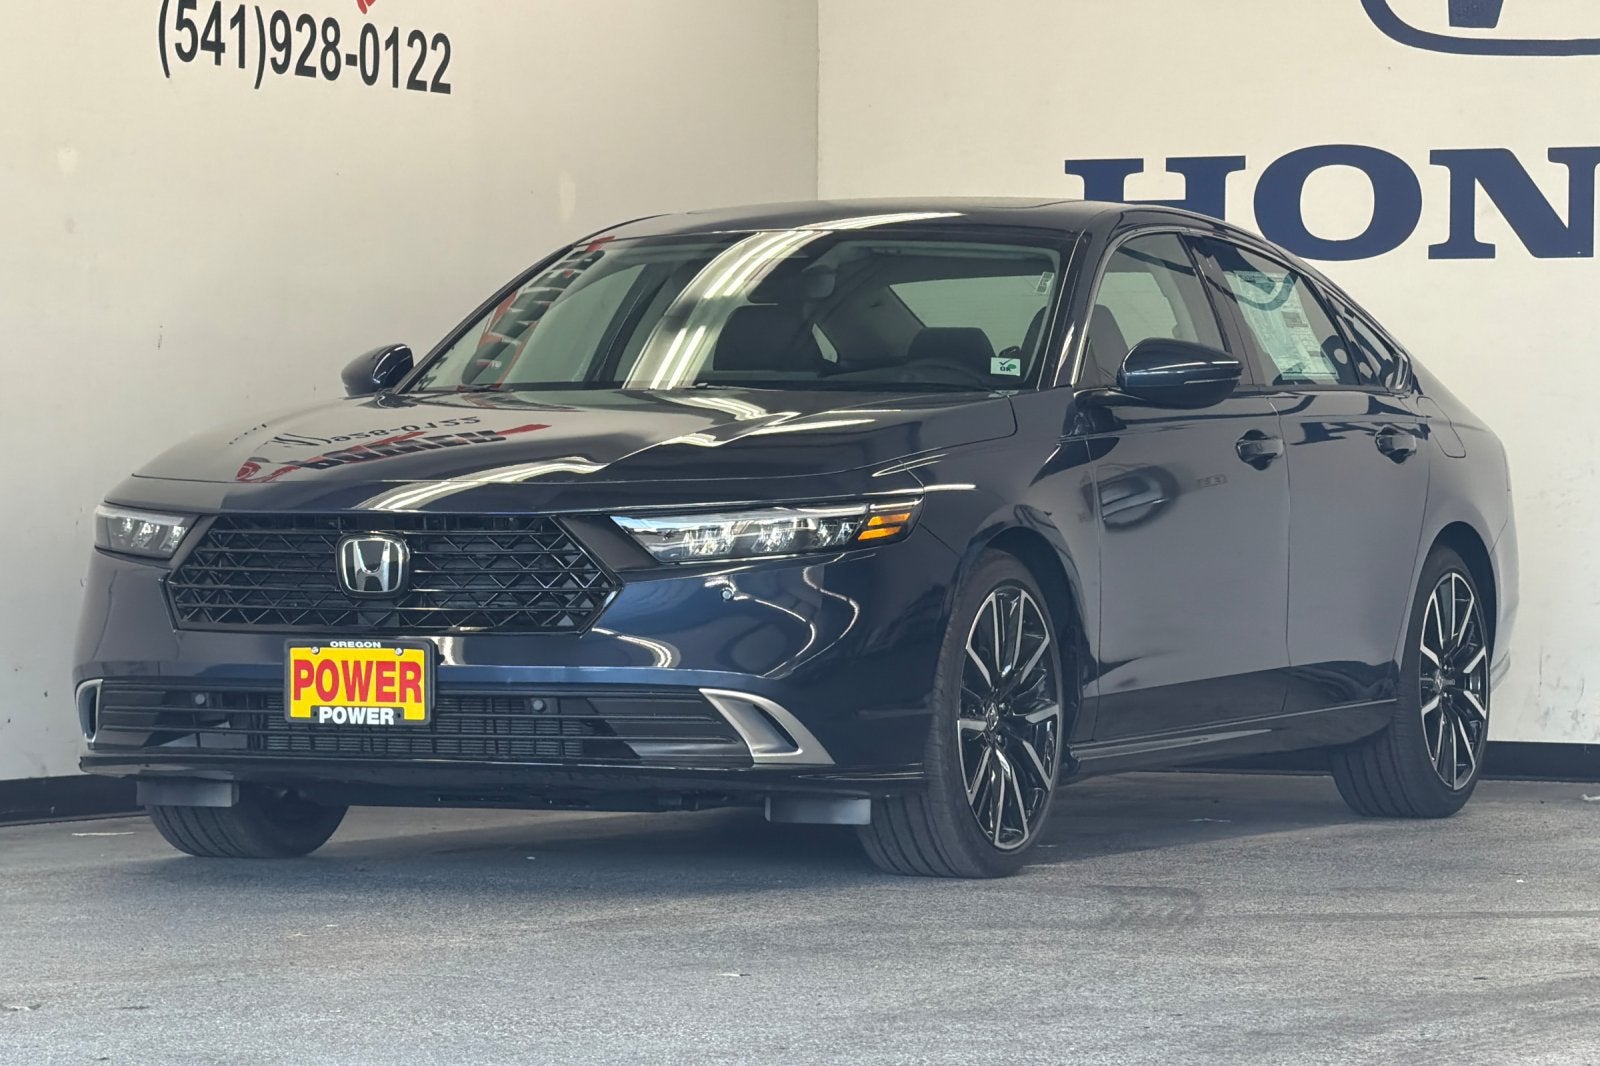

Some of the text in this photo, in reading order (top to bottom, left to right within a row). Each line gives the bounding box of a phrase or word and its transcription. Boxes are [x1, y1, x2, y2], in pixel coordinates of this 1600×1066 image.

[159, 0, 451, 94] (541)928-0122
[293, 659, 422, 703] POWER
[319, 706, 394, 725] POWER
